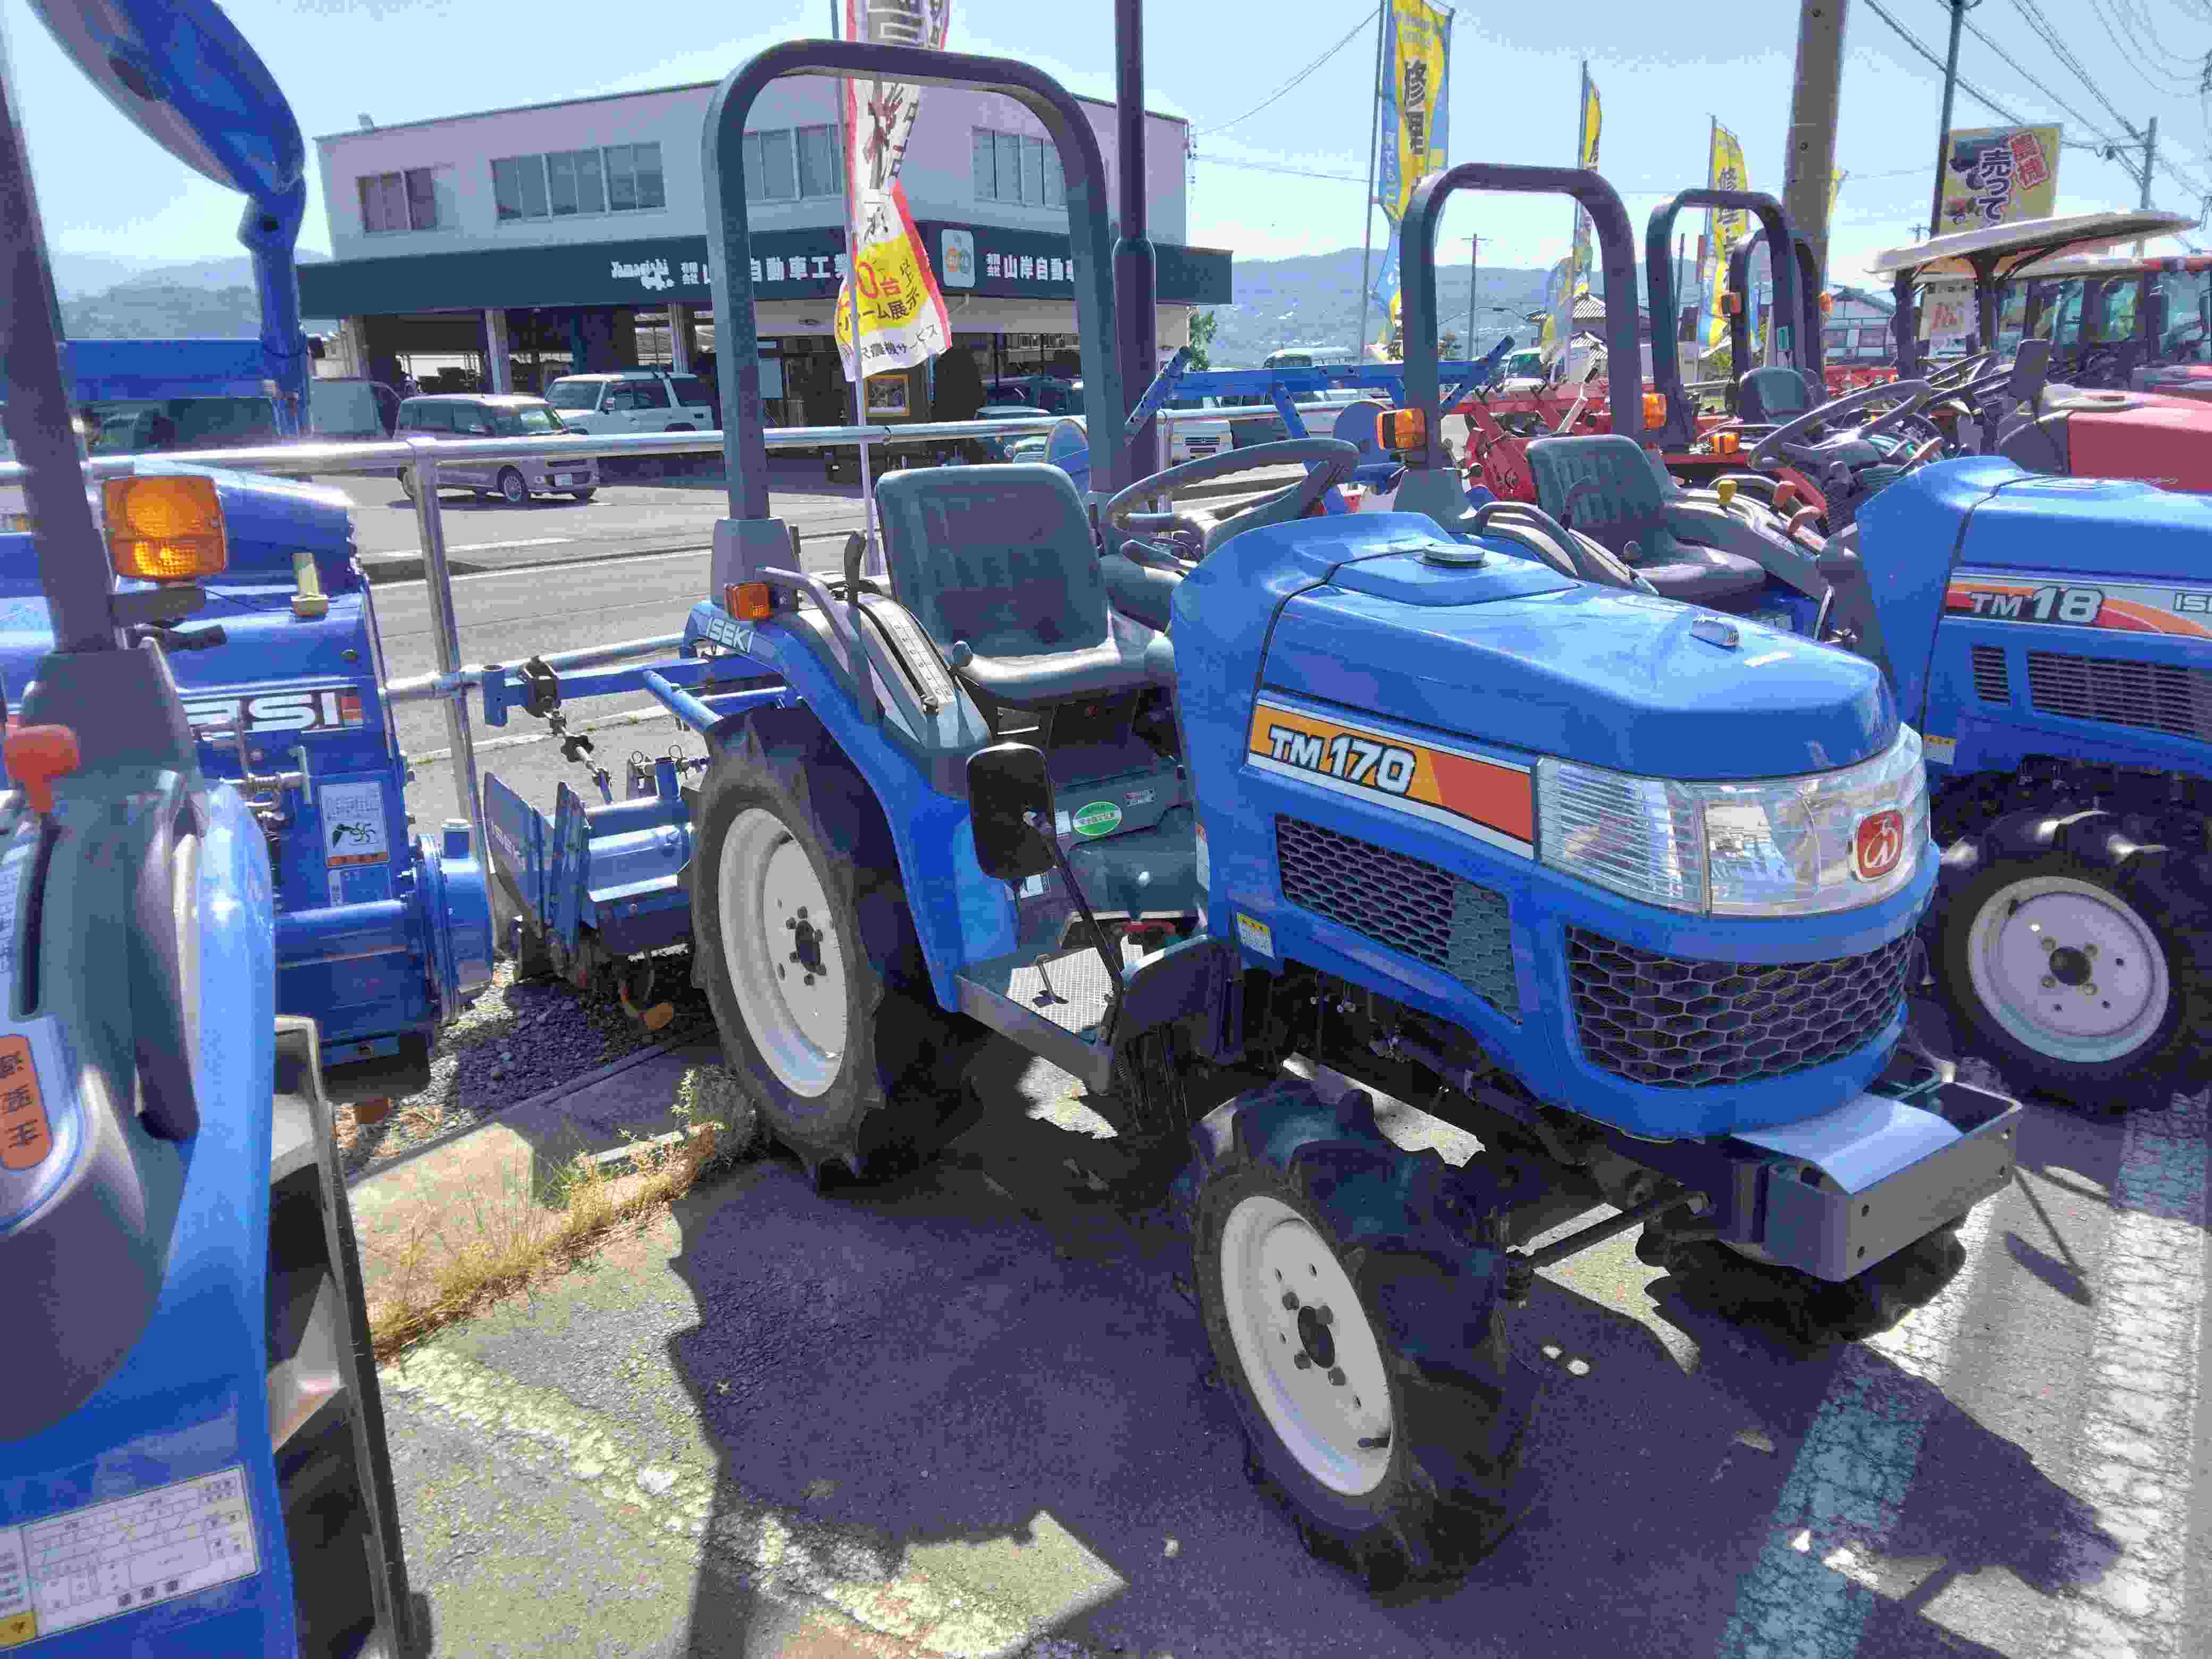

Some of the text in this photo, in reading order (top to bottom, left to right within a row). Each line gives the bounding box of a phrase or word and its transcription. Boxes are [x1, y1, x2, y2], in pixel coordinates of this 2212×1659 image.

[1970, 586, 2212, 623] TM18 IS
[706, 616, 756, 656] ISEKI
[1269, 724, 1418, 797] TM170
